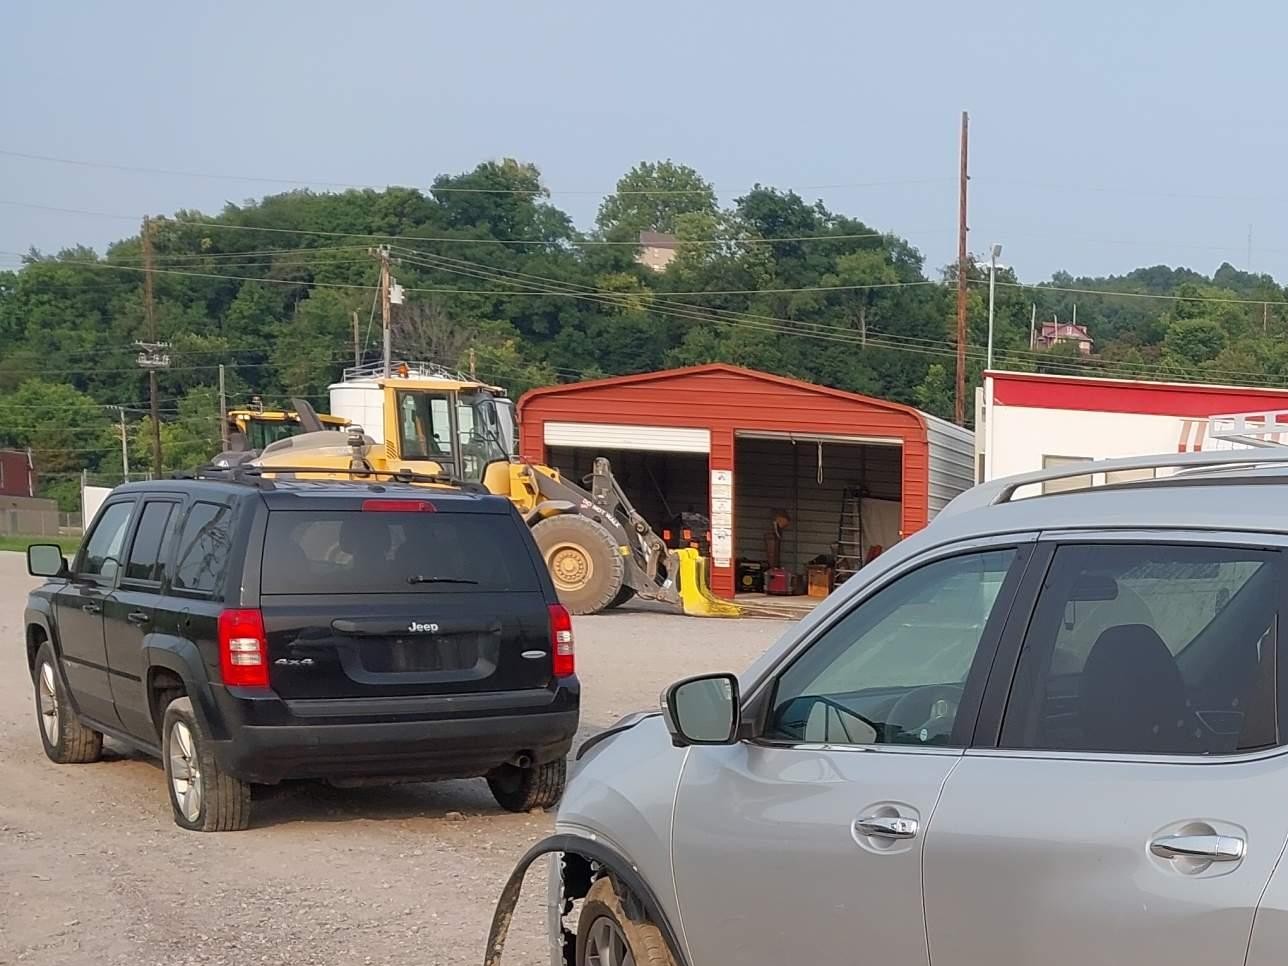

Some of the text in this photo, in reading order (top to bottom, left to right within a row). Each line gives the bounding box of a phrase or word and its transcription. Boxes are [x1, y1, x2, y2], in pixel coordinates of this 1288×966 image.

[592, 504, 606, 516] NOT
[605, 511, 621, 528] WALK
[408, 621, 439, 634] Jeep
